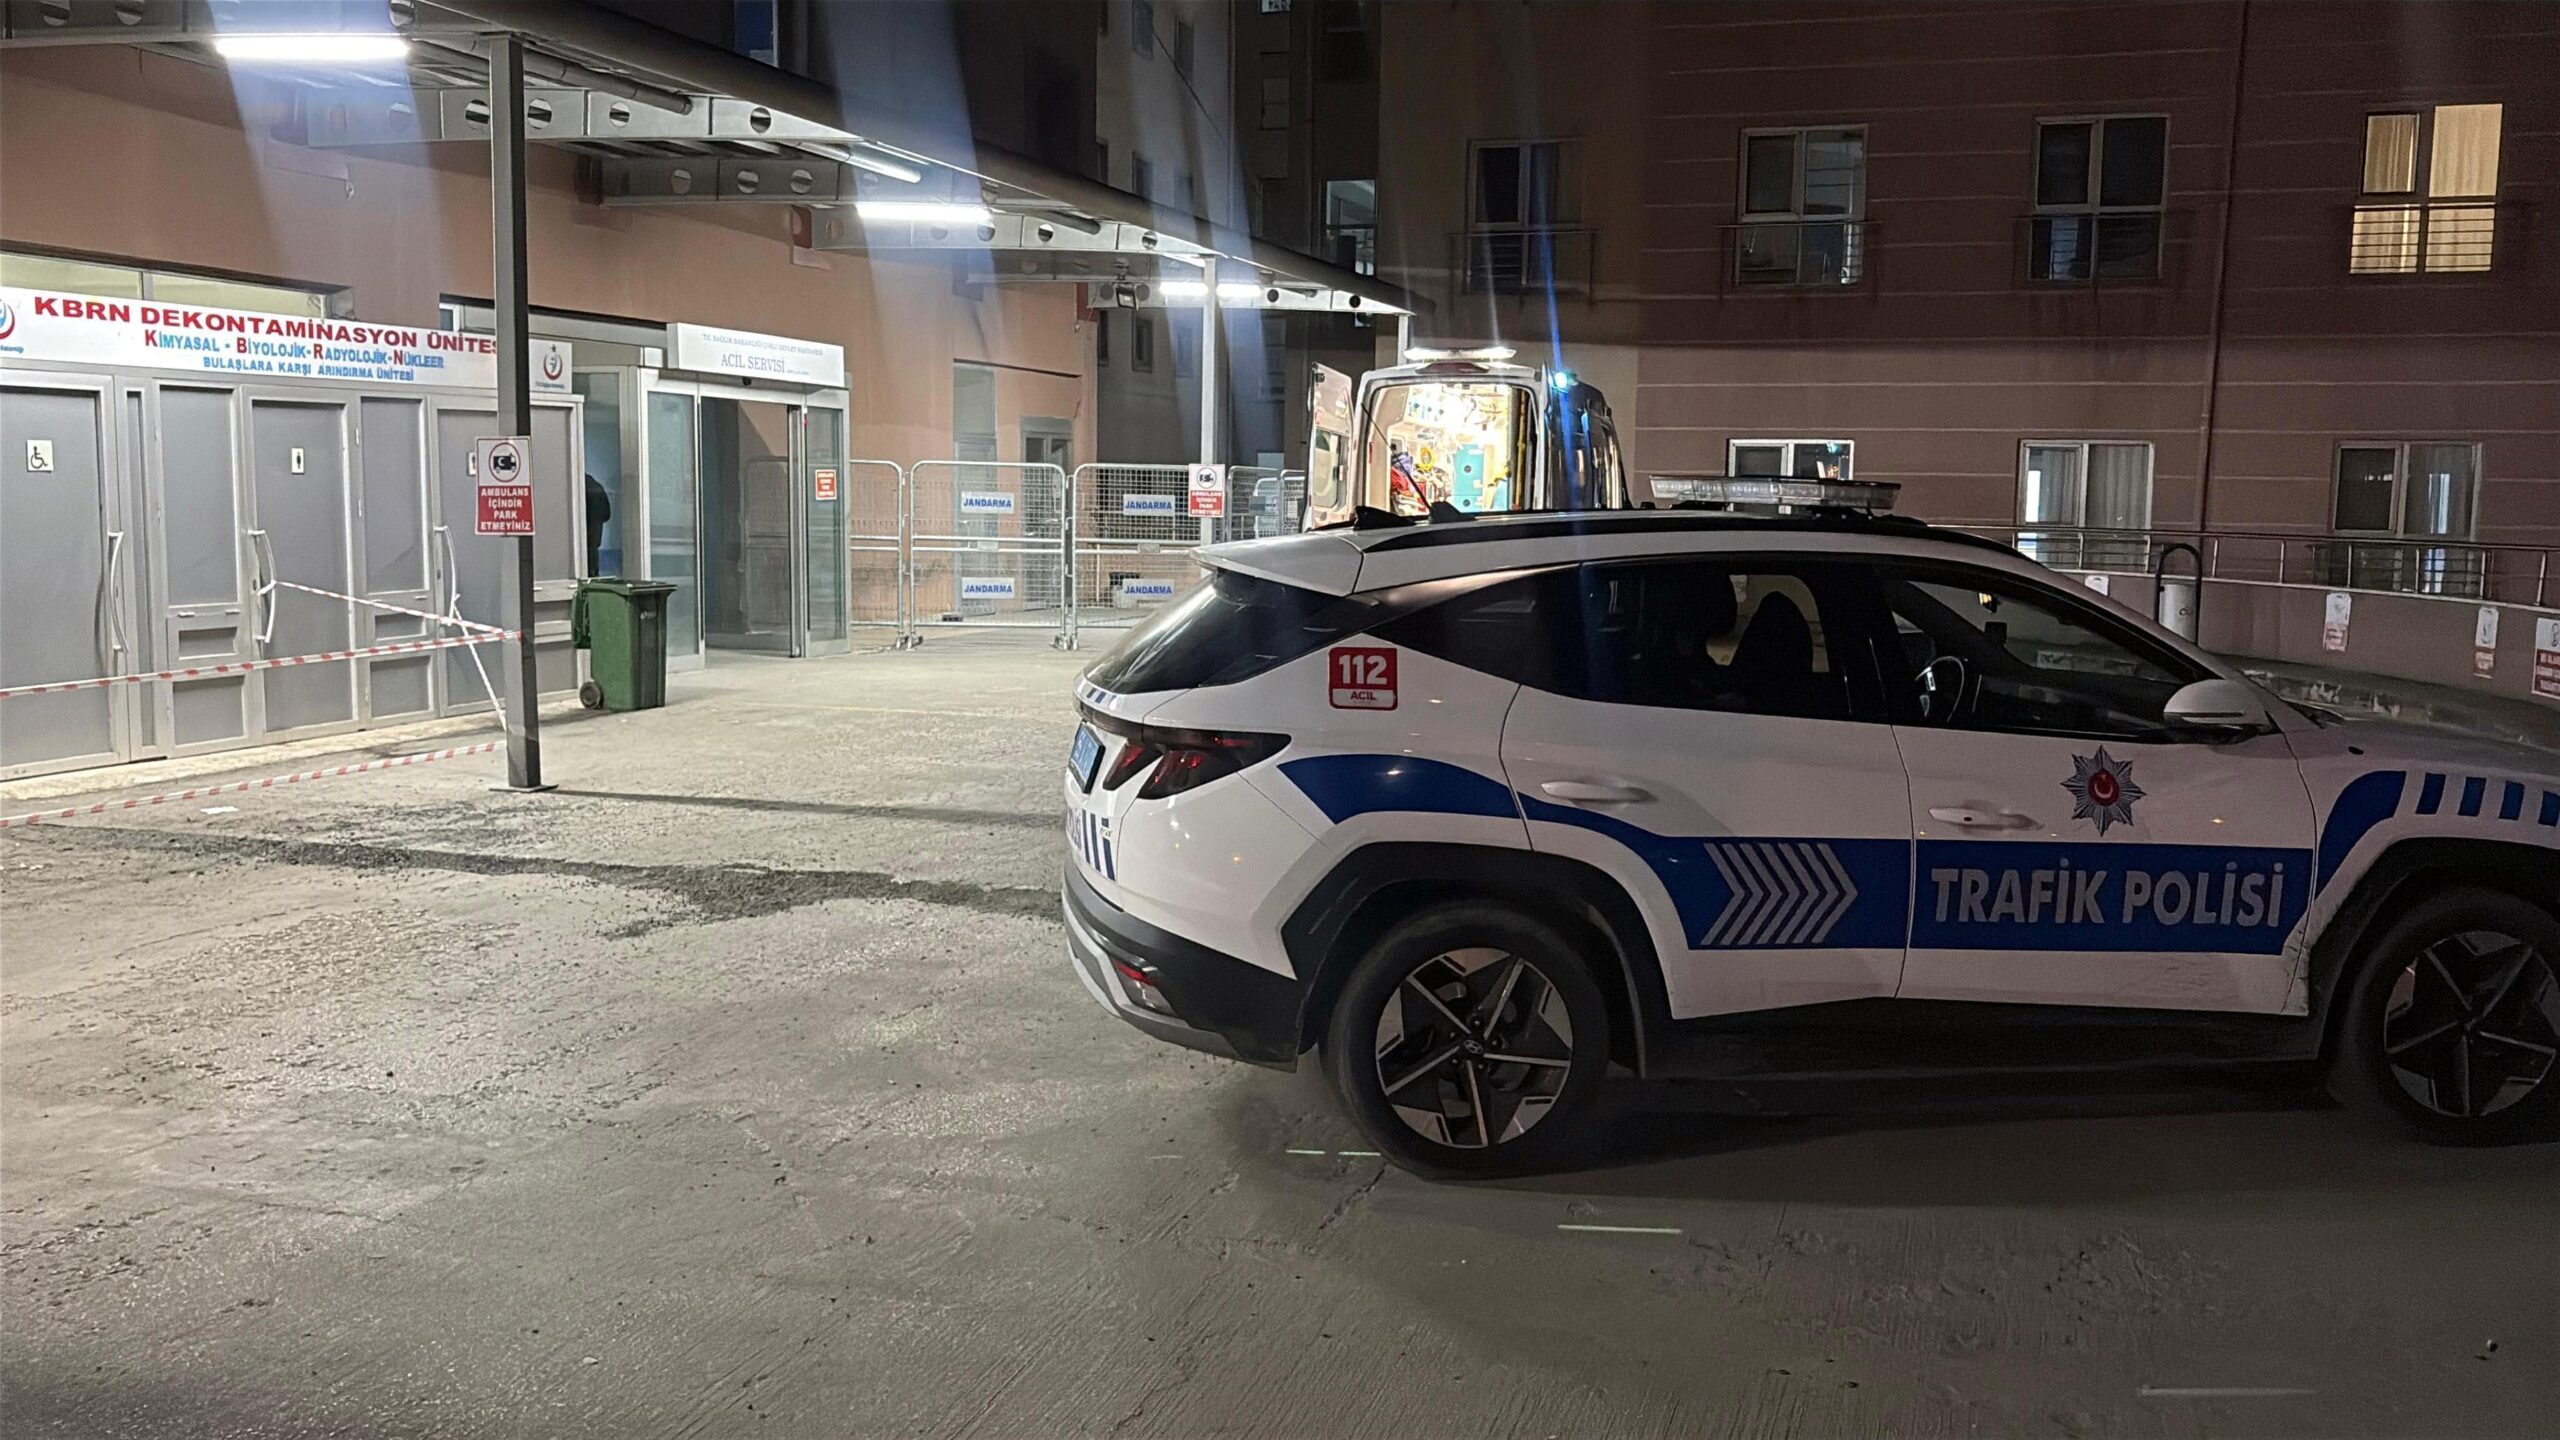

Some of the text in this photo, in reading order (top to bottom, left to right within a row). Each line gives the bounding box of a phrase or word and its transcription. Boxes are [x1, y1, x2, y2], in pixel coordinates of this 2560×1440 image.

[34, 297, 131, 323] KBRN
[141, 307, 417, 348] DEKONTAMİNASYON
[145, 329, 220, 352] KİMYASAL
[721, 350, 746, 368] ACİL
[203, 356, 414, 381] BULAŞLARA KARŞI ARINDIRMA ÜNİTESİ
[481, 487, 529, 497] AMBULANS
[488, 497, 523, 510] İÇİNDİR
[963, 498, 1012, 508] JANDARMA
[1125, 501, 1172, 510] JANDARMA
[493, 510, 518, 519] PARK
[480, 520, 531, 531] ETMEYİNİZ
[964, 584, 1013, 593] JANDARMA
[1125, 586, 1173, 594] JANDARMA
[1339, 654, 1387, 685] 112
[1931, 858, 2284, 927] TRAFİK POLİSİ
